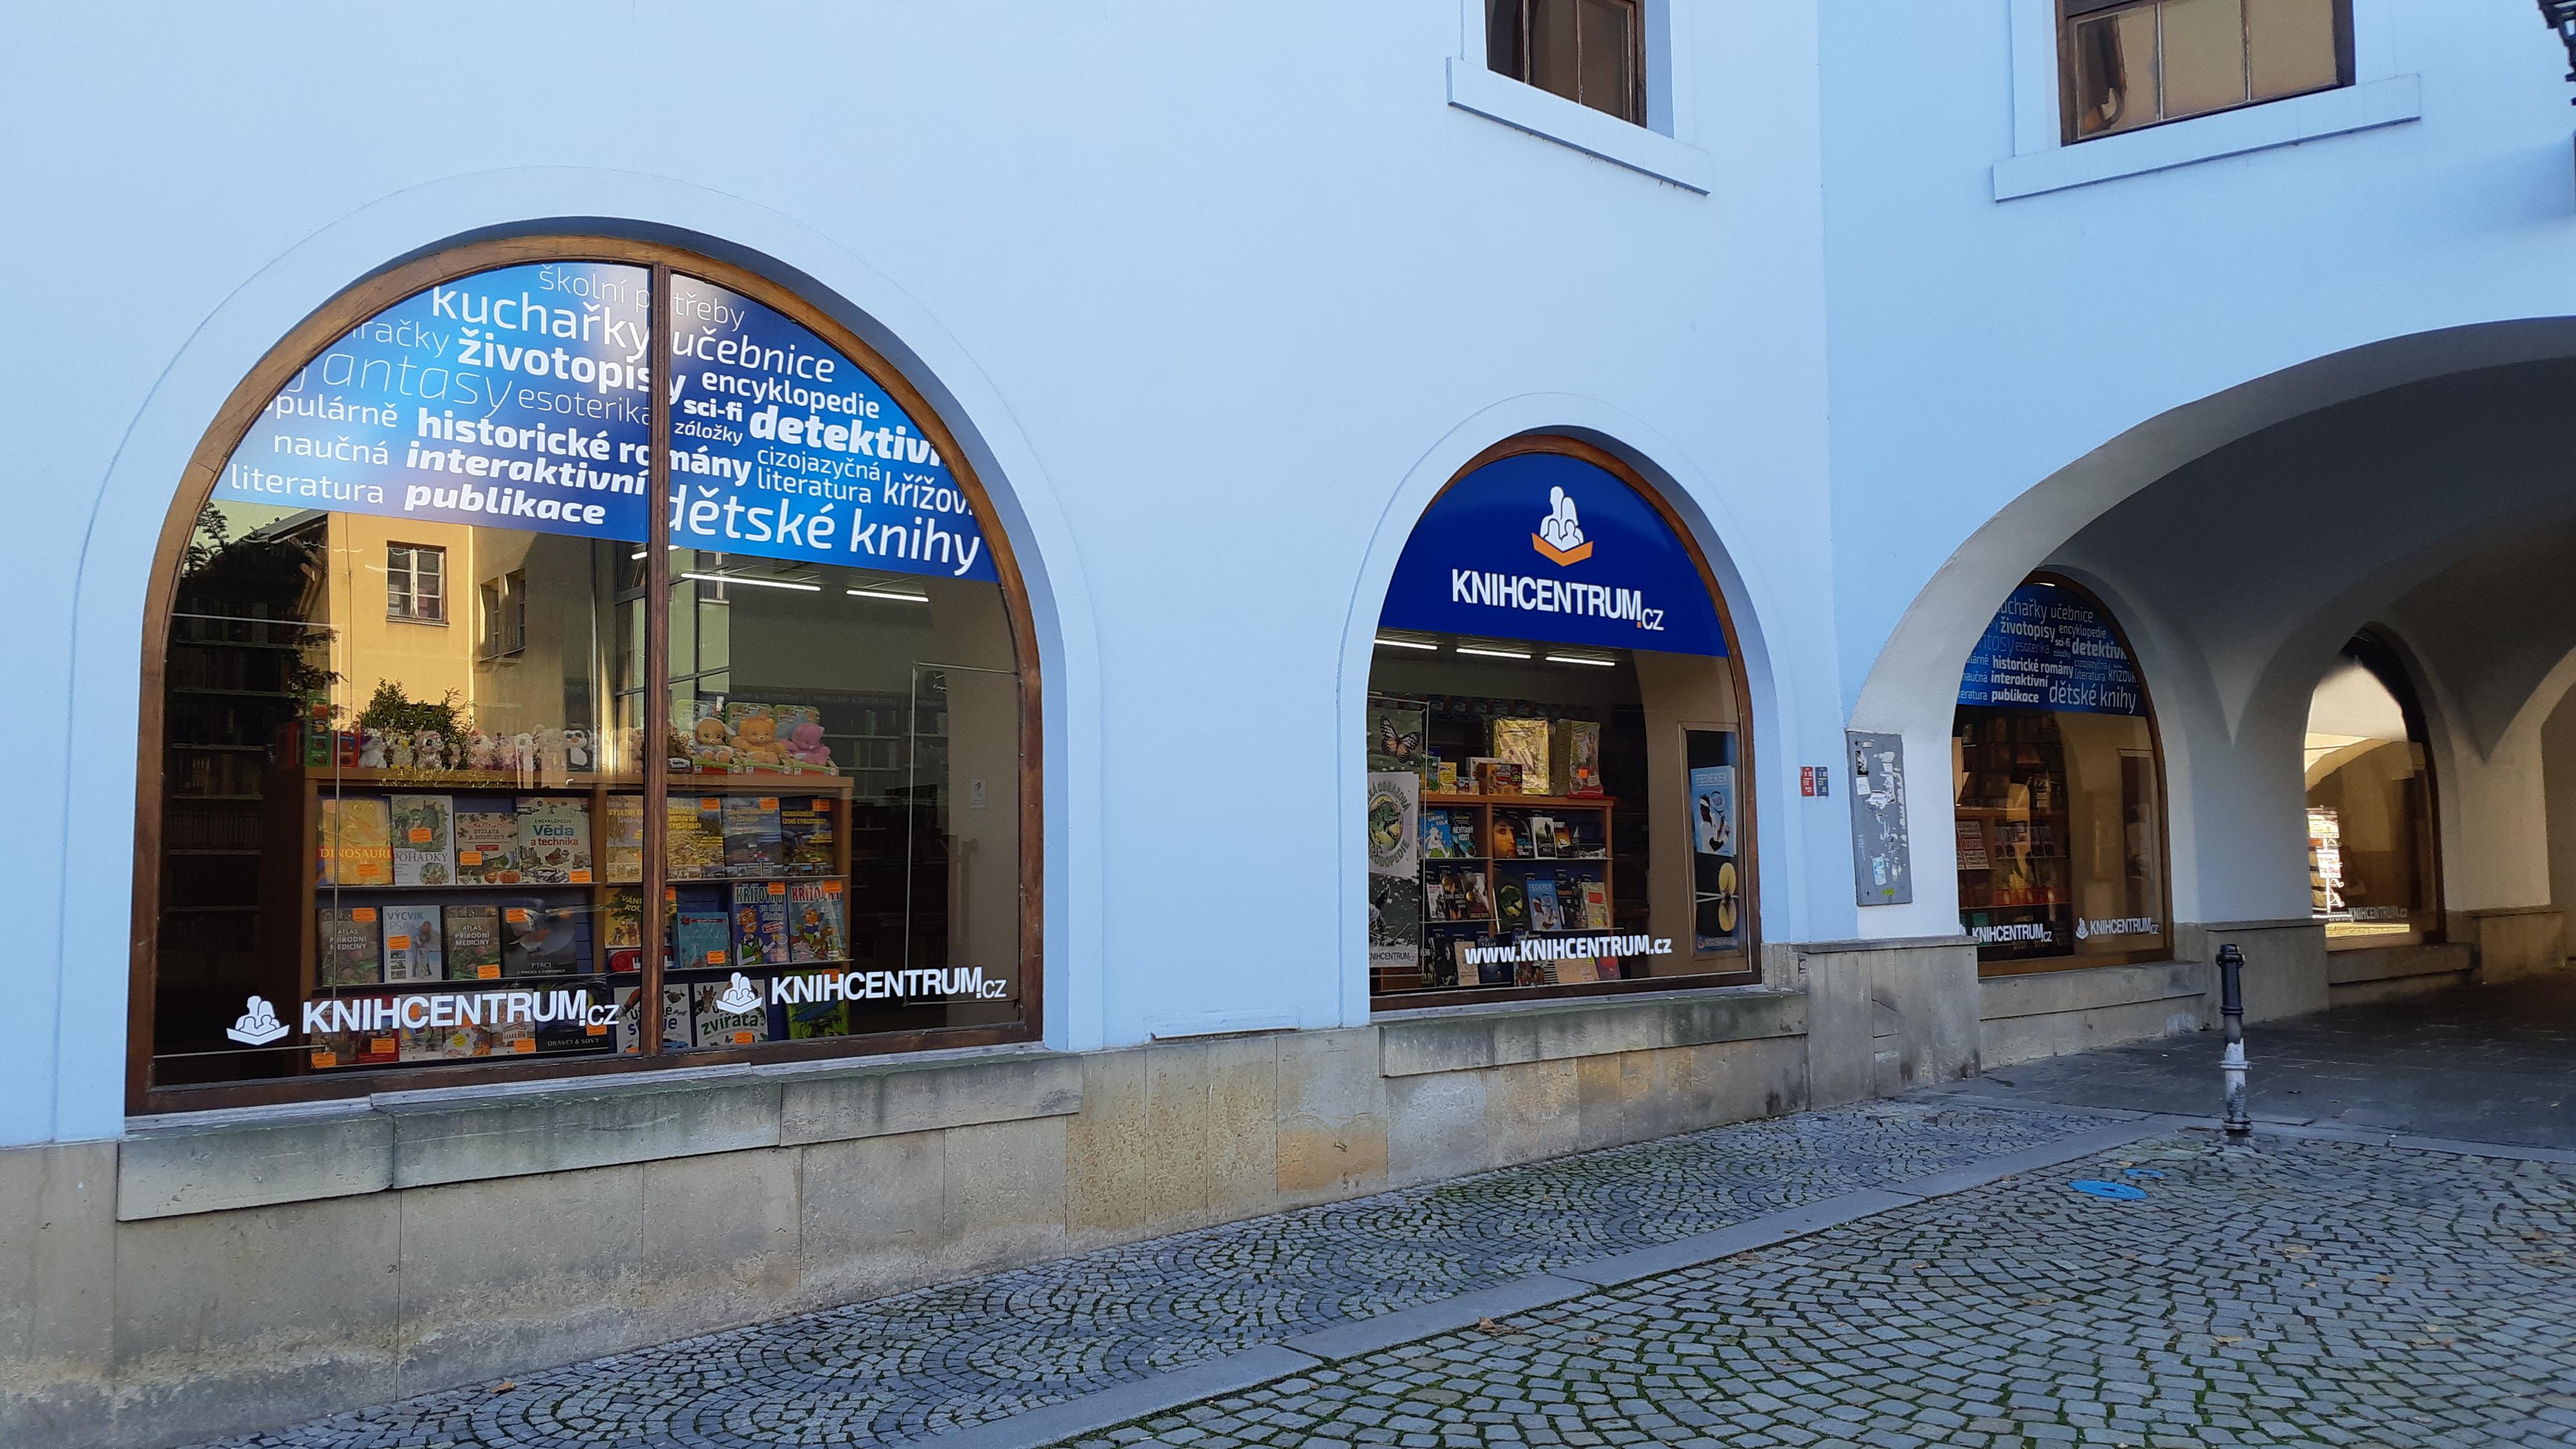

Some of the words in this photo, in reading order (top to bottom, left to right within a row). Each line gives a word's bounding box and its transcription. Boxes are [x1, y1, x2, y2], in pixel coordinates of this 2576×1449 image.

[539, 263, 627, 303] školní
[636, 288, 745, 332] ptřeby
[432, 285, 649, 363] kuchařky
[353, 319, 450, 357] račky
[673, 327, 835, 383] učebnice
[518, 387, 649, 426] esoterika
[701, 370, 880, 419] encyklopedie
[264, 393, 397, 428] pulárně
[683, 398, 743, 422] sci-fi
[674, 421, 743, 446] záložky
[749, 404, 941, 467] detektiv
[274, 434, 388, 466] naučná
[417, 407, 610, 460] historické
[620, 442, 752, 486] romány
[406, 440, 649, 495] interaktivní
[757, 446, 881, 481] cizojazyčná
[231, 463, 384, 505] literatura
[758, 466, 872, 504] literatura
[883, 471, 973, 516] křížov
[403, 482, 606, 525] publikace
[669, 484, 835, 549] dětské
[849, 507, 980, 576] knihy
[1998, 596, 2048, 625] uchařky
[2050, 603, 2094, 623] učebnice
[2000, 616, 2056, 643] životopisy
[2054, 637, 2071, 647] sci-fi
[2058, 623, 2107, 639] encyklopedie
[1978, 634, 2014, 658] ntasy
[2015, 640, 2050, 654] esoterika
[2071, 637, 2128, 661] detektivk
[1962, 670, 1988, 683] naučná
[1992, 654, 2039, 673] historické
[2040, 660, 2074, 679] romány
[2074, 658, 2108, 670] cizojazyčná
[2074, 668, 2107, 681] literatura
[2108, 663, 2137, 684] křížovk
[1991, 670, 2049, 688] interaktivní
[1958, 689, 1988, 701] teratura
[1991, 687, 2040, 703] publikace
[2049, 680, 2097, 706] dětské
[2099, 683, 2136, 715] knihy
[1696, 772, 1727, 784] FEDERER
[533, 824, 574, 836] Věda
[538, 837, 578, 846] technika
[1529, 883, 1553, 891] FEDERER
[387, 910, 424, 920] VÝCVIK
[390, 921, 408, 930] PSA
[701, 1011, 759, 1036] zvířata
[547, 1038, 573, 1047] DRAVCI
